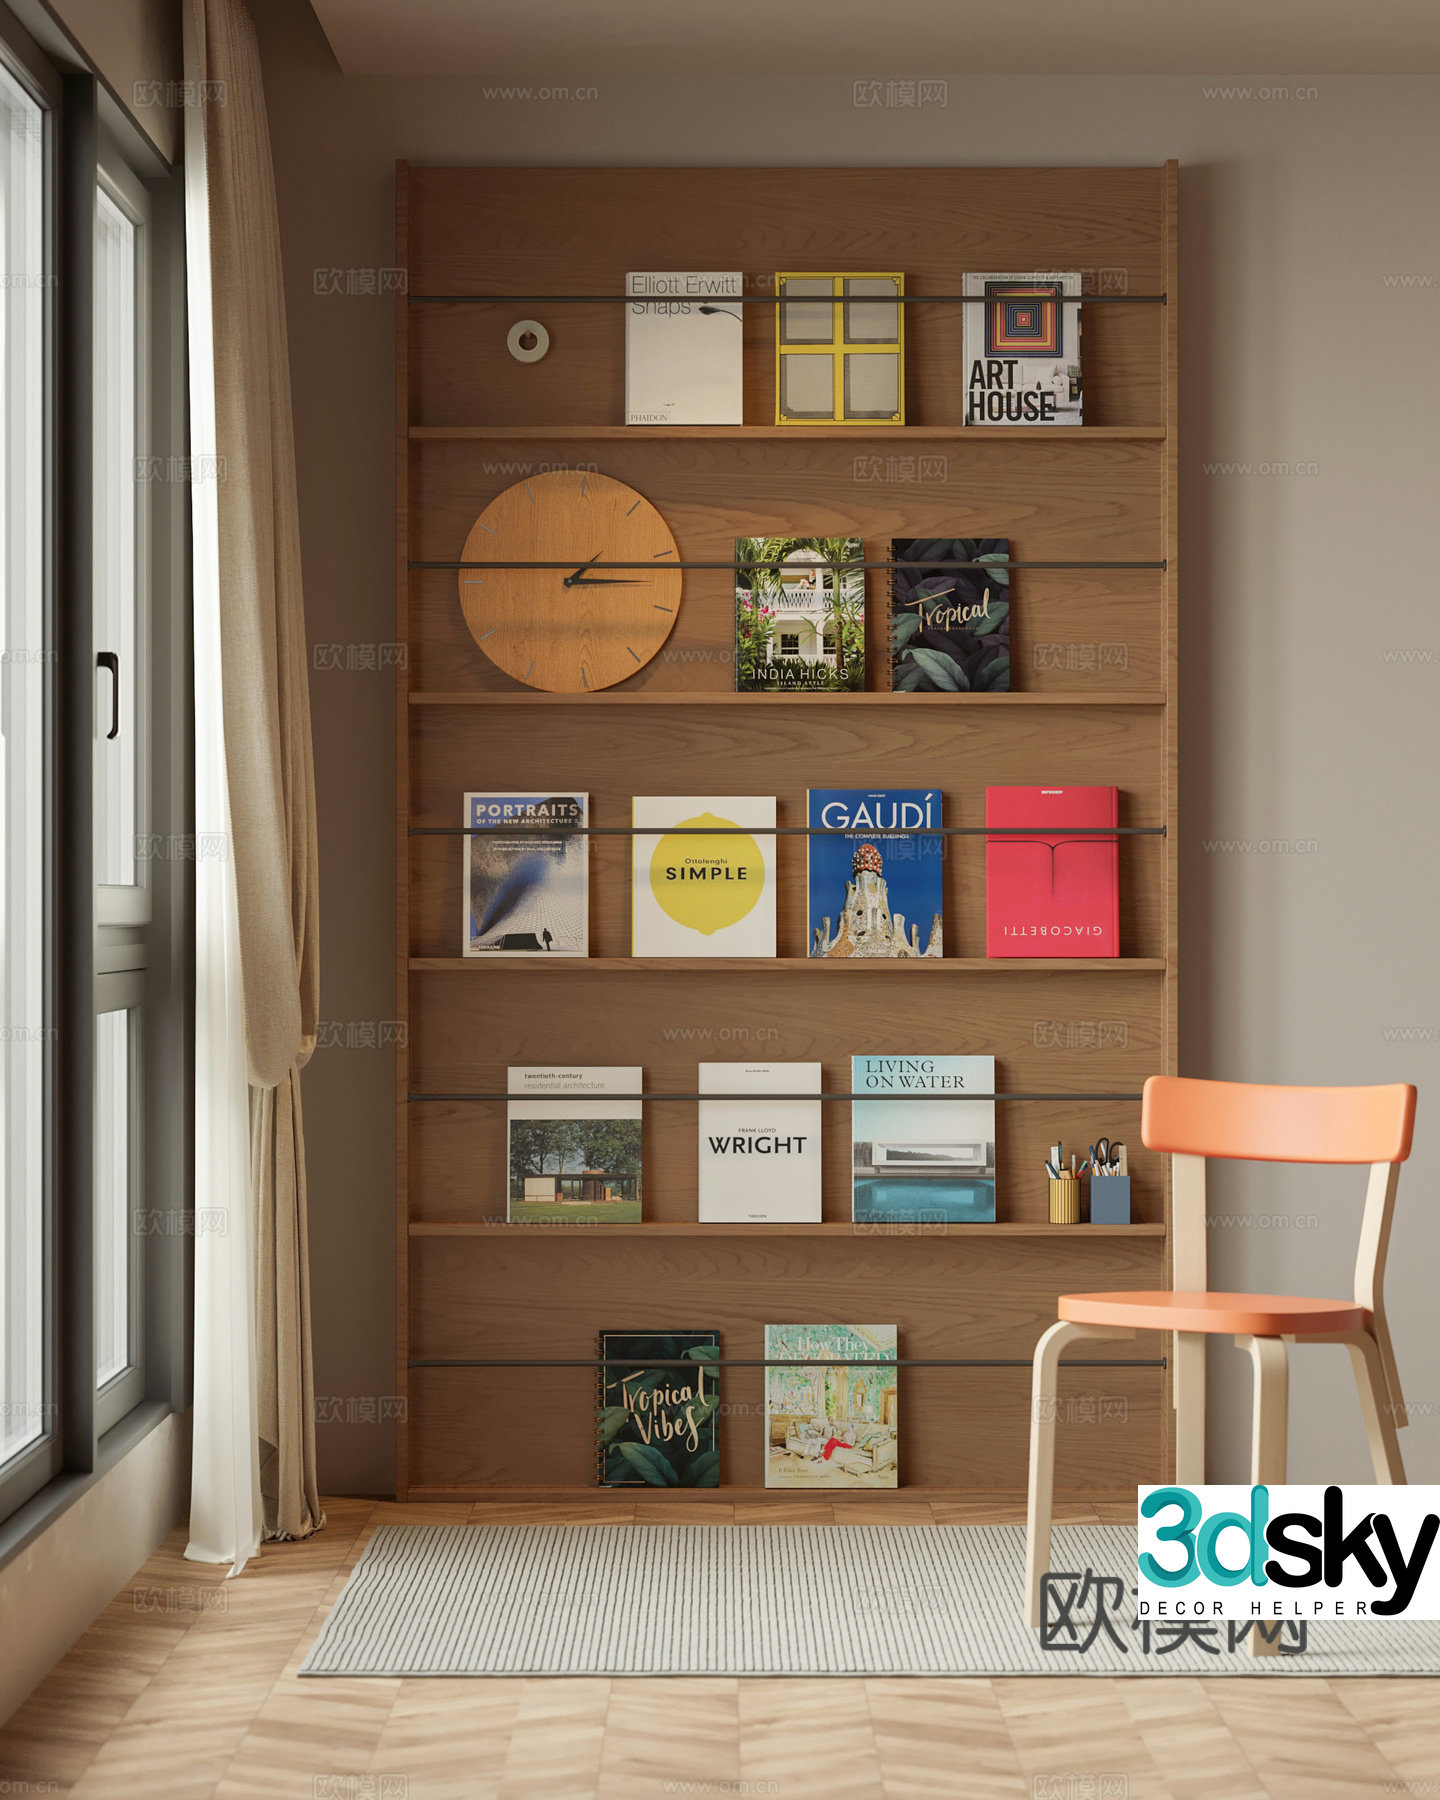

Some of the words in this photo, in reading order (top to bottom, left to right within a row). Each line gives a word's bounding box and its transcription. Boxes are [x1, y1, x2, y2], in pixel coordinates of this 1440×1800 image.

[632, 275, 680, 294] Elliott
[686, 275, 736, 294] Erwitt
[632, 302, 691, 318] Snaps
[969, 360, 1018, 390] ART
[969, 391, 1054, 422] HOUSE
[630, 414, 668, 422] PHAIDON
[904, 587, 991, 632] Tropical
[752, 669, 795, 680] INDIA
[801, 668, 849, 680] HICKS
[476, 804, 578, 817] PORTRAITS
[821, 793, 933, 829] GAUDÍ
[666, 867, 747, 880] SIMPLE
[1004, 926, 1102, 936] GIACOBETTI
[866, 1060, 935, 1073] LIVING
[866, 1075, 894, 1088] ON
[899, 1075, 965, 1088] WATER
[708, 1137, 807, 1154] WRIGHT
[797, 1337, 830, 1351] How
[832, 1337, 869, 1353] They
[606, 1366, 710, 1423] Tropical
[634, 1406, 704, 1453] Vibes
